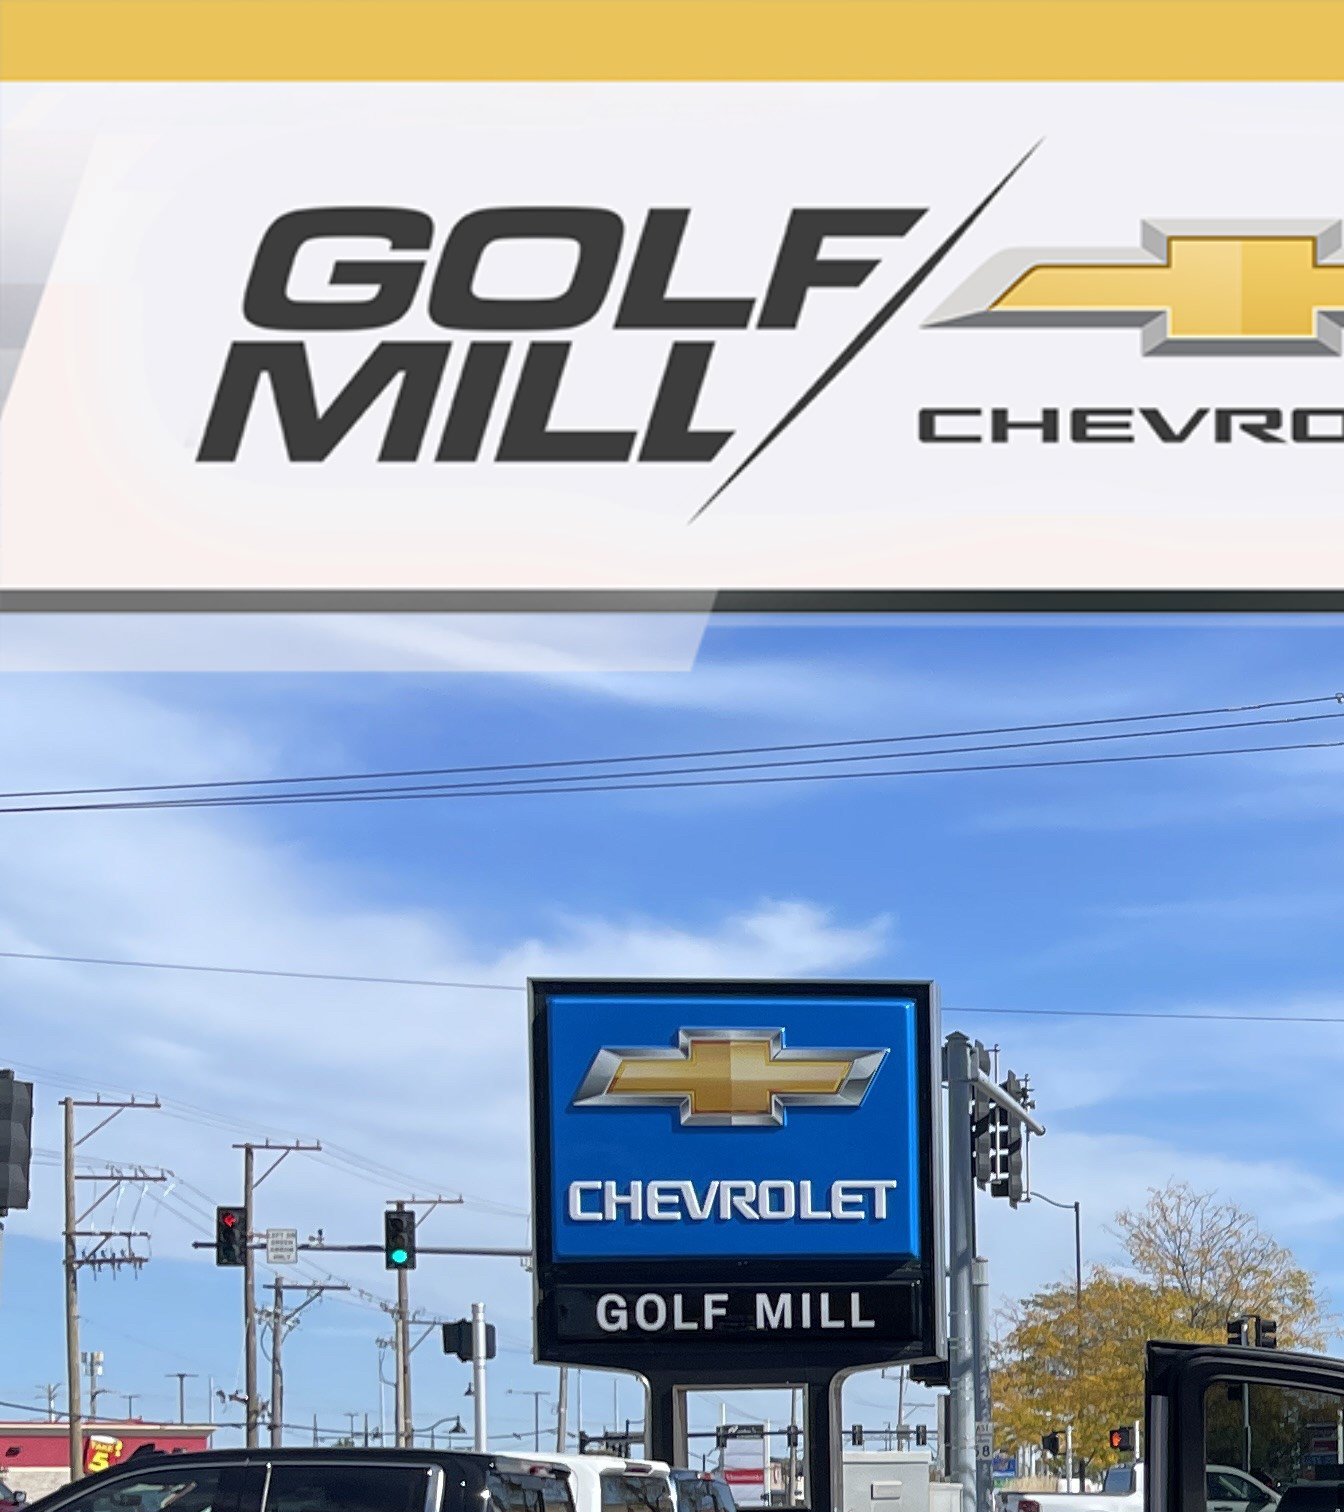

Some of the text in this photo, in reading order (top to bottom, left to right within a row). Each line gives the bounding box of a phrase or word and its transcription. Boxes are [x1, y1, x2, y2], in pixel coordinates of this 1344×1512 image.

[569, 1179, 897, 1222] CHEVROLET
[596, 1292, 875, 1331] GOLF MILL
